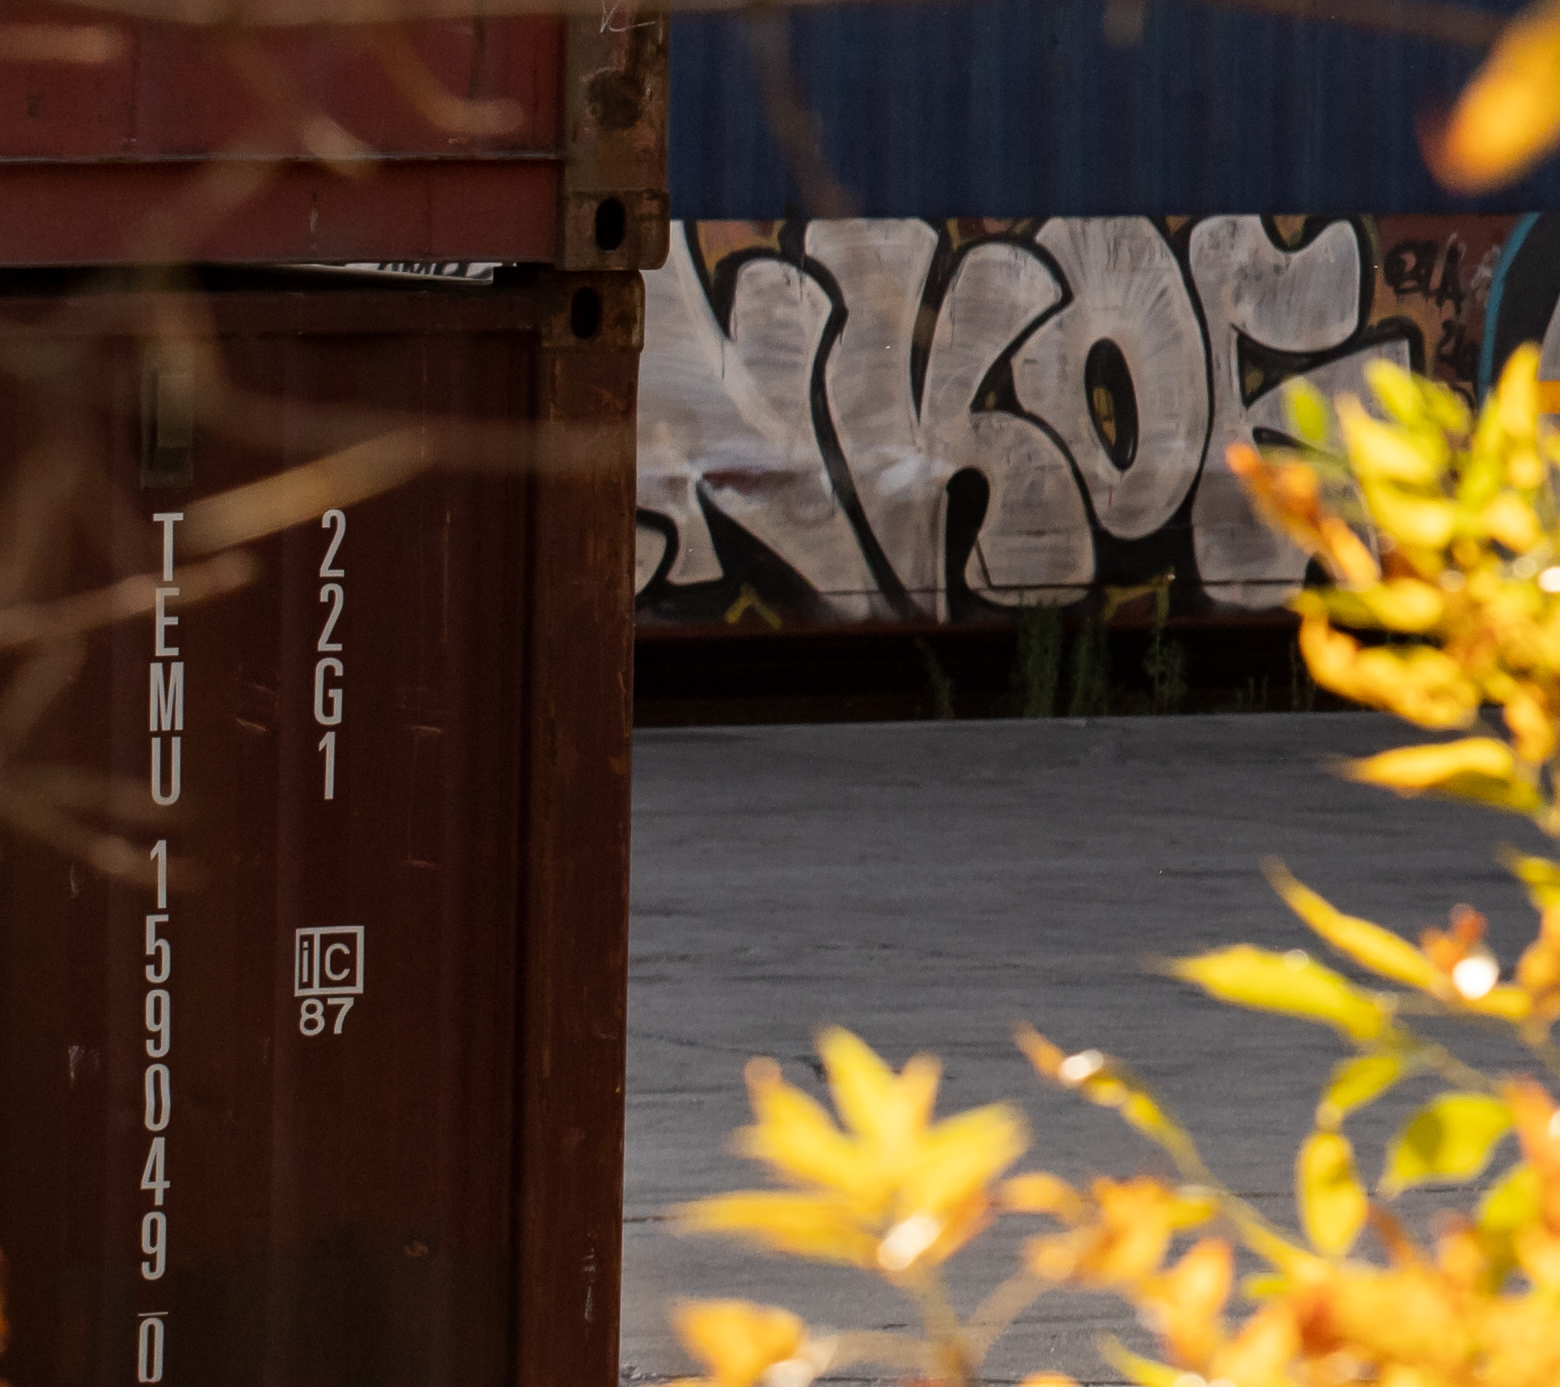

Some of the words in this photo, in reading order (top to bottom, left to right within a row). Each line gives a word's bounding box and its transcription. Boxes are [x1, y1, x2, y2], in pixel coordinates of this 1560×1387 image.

[148, 511, 185, 806] TEMU
[312, 509, 347, 802] 22G1
[139, 838, 173, 1283] 159049
[299, 996, 355, 1037] 87
